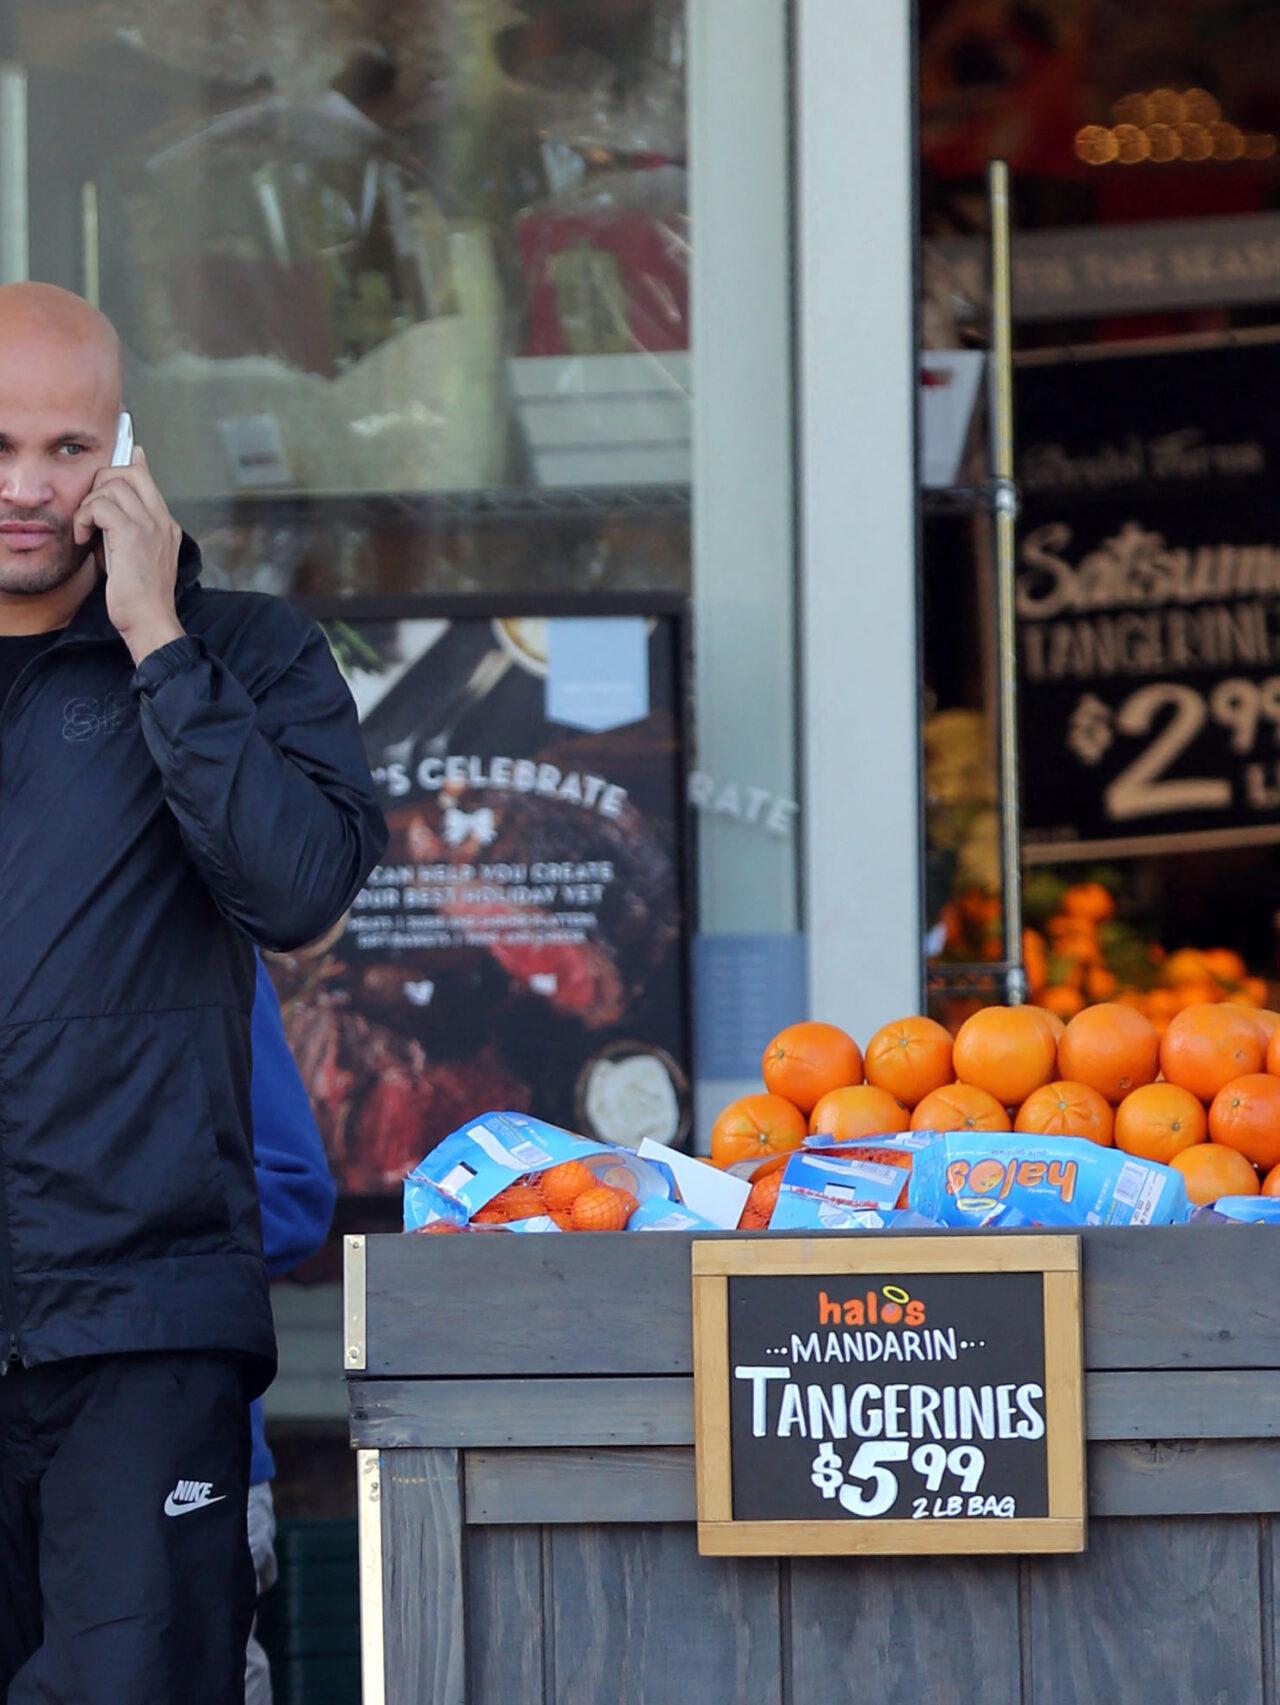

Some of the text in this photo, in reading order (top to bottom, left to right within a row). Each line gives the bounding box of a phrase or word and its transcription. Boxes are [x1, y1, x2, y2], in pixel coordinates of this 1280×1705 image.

[1017, 522, 1280, 619] Satsum
[1023, 602, 1280, 682] TANGERIN
[417, 755, 628, 818] CELEBRATE
[417, 864, 476, 886] HELP
[478, 863, 528, 883] YOU
[530, 861, 614, 883] CREATE
[352, 888, 400, 909] OUR
[459, 885, 557, 906] HOLIDAY
[560, 884, 606, 904] YET
[945, 1157, 1078, 1204] halos
[818, 1291, 926, 1327] halos
[791, 1327, 958, 1363] MANDARIN
[734, 1366, 1045, 1440] TANGERINES
[173, 1479, 213, 1501] NIKE
[912, 1495, 1016, 1519] 2 LB BAG
